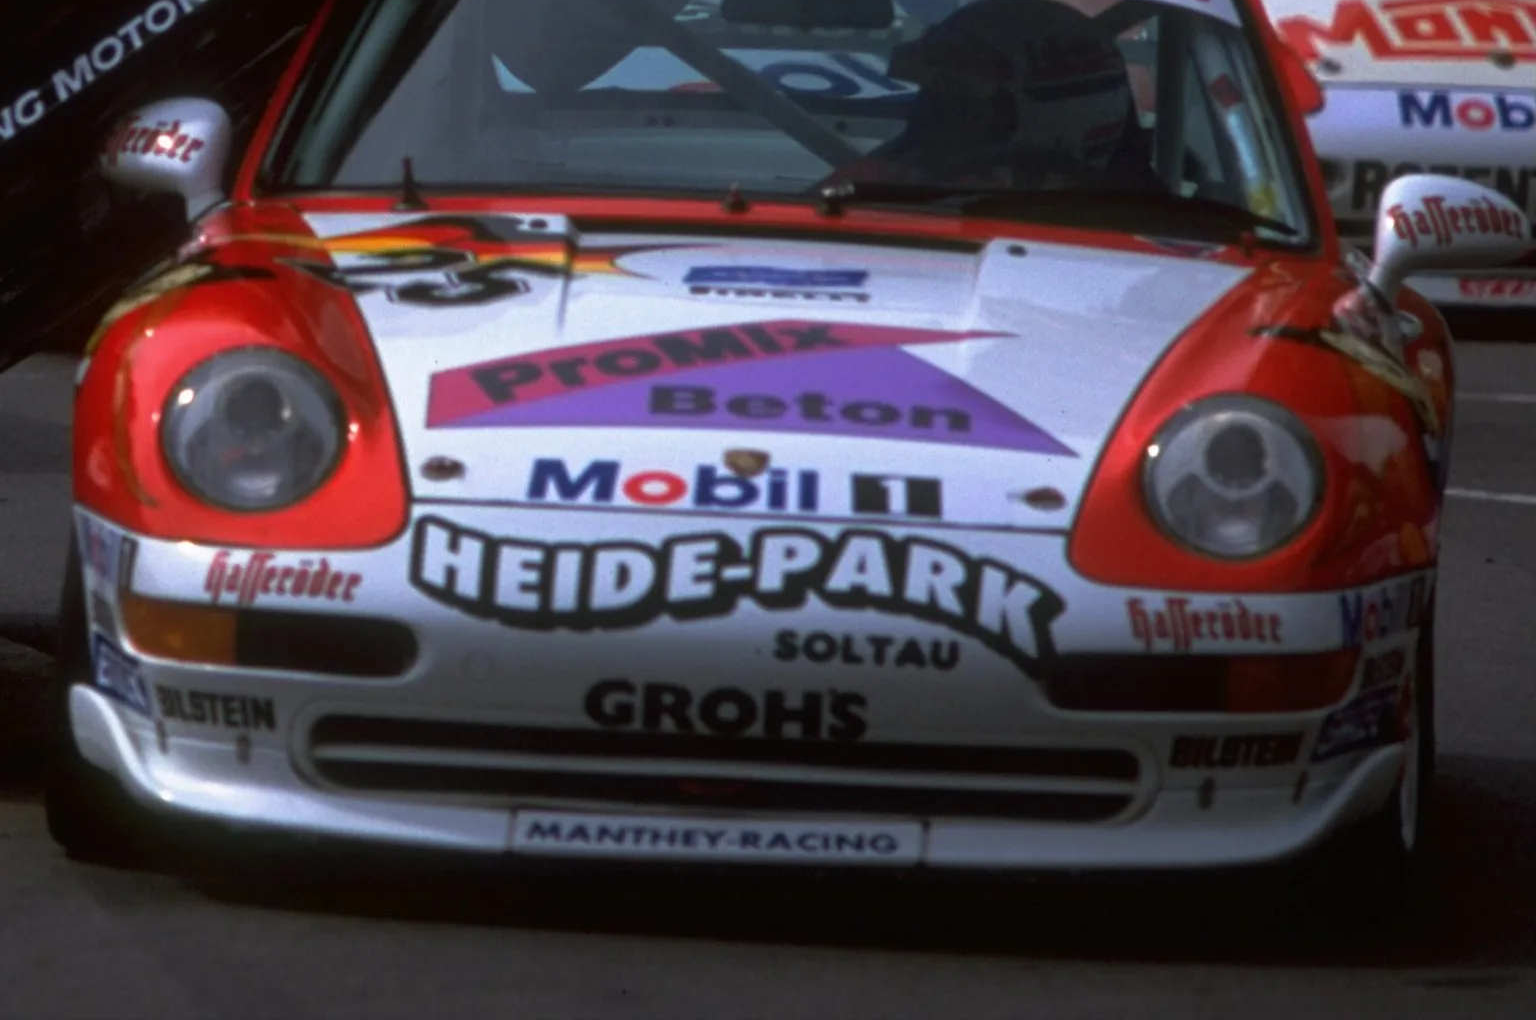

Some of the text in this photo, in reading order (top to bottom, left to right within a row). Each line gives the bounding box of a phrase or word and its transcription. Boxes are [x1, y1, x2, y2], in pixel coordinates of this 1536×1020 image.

[1398, 88, 1536, 132] Mob
[648, 383, 973, 434] Beton
[525, 457, 820, 512] Mobil
[410, 514, 1069, 670] HEIDE-PARK
[773, 628, 961, 672] SOLTAU
[524, 818, 902, 857] MANTHEY-RACING
